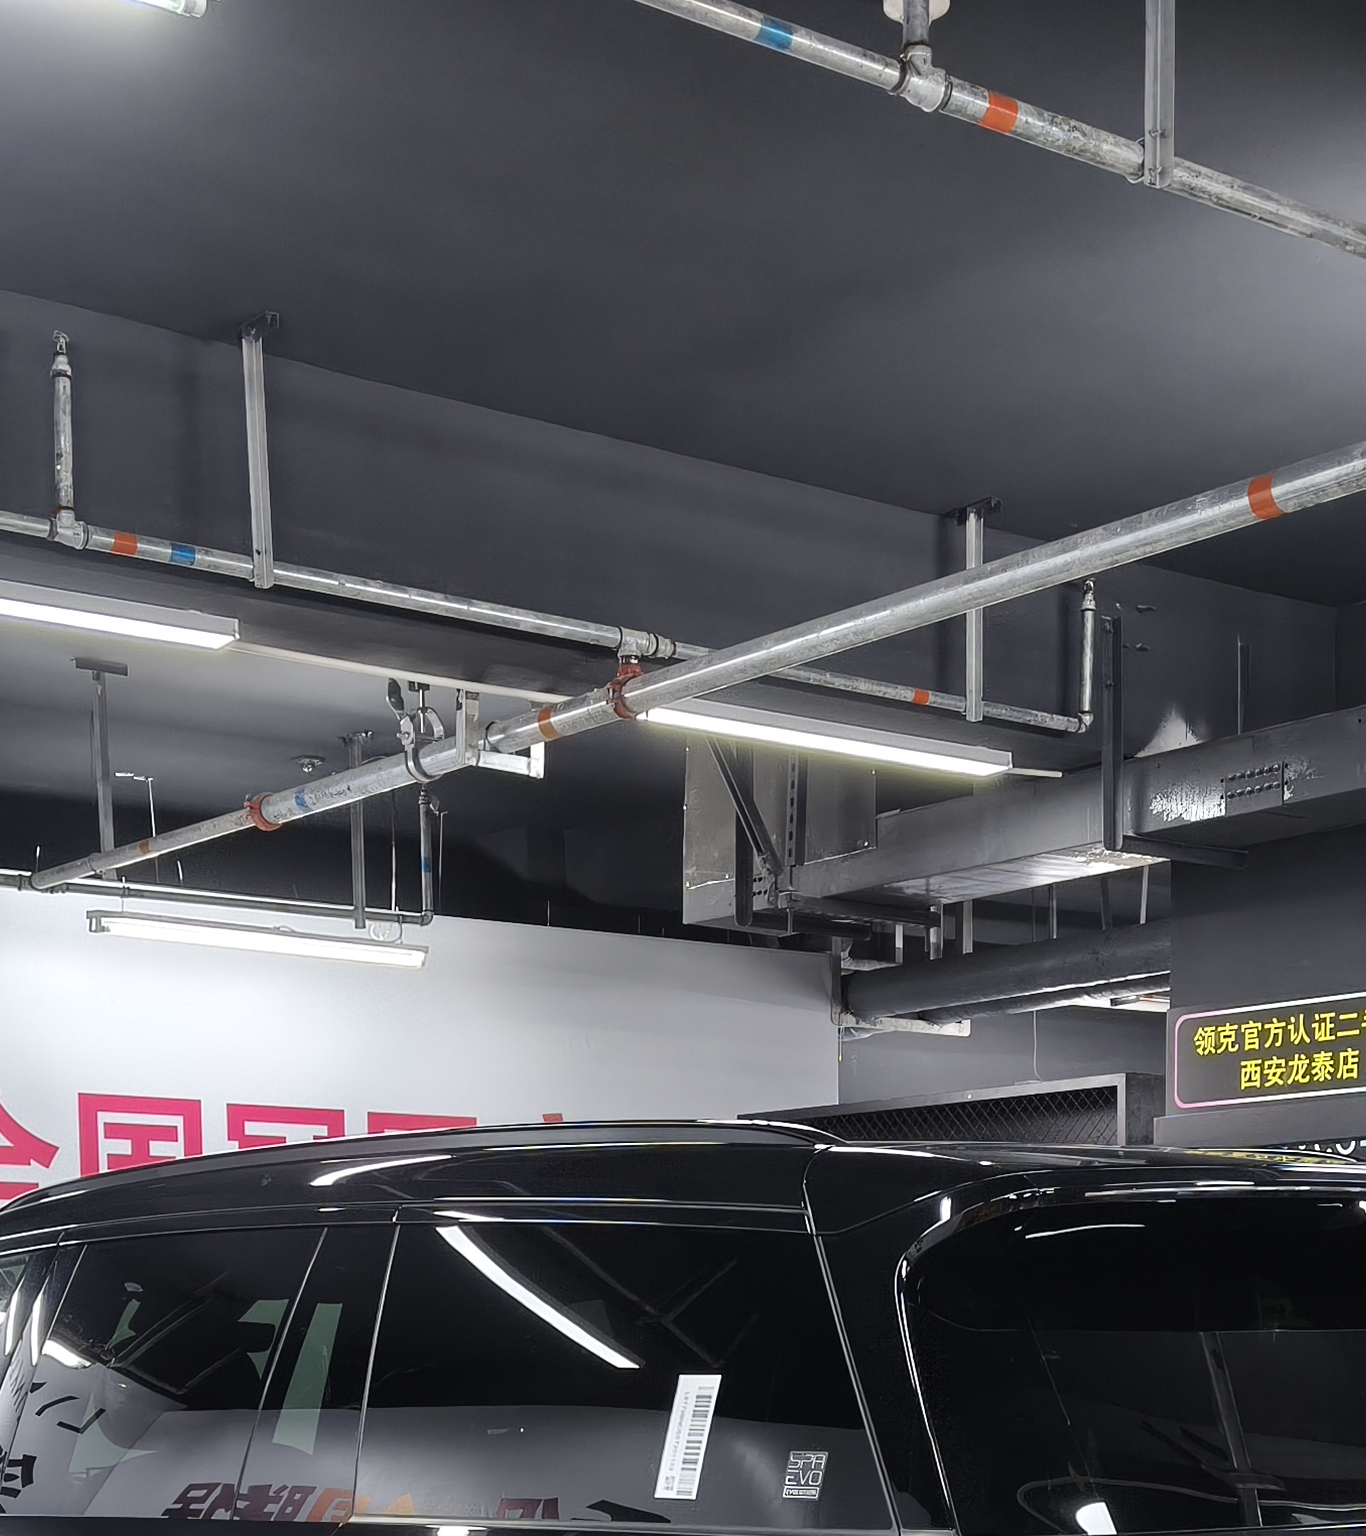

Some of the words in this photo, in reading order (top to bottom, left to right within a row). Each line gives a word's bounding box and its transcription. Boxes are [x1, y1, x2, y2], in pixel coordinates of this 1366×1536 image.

[1239, 1047, 1361, 1090] 西安龙泰店
[788, 1453, 826, 1469] SPA
[785, 1470, 823, 1486] EVO
